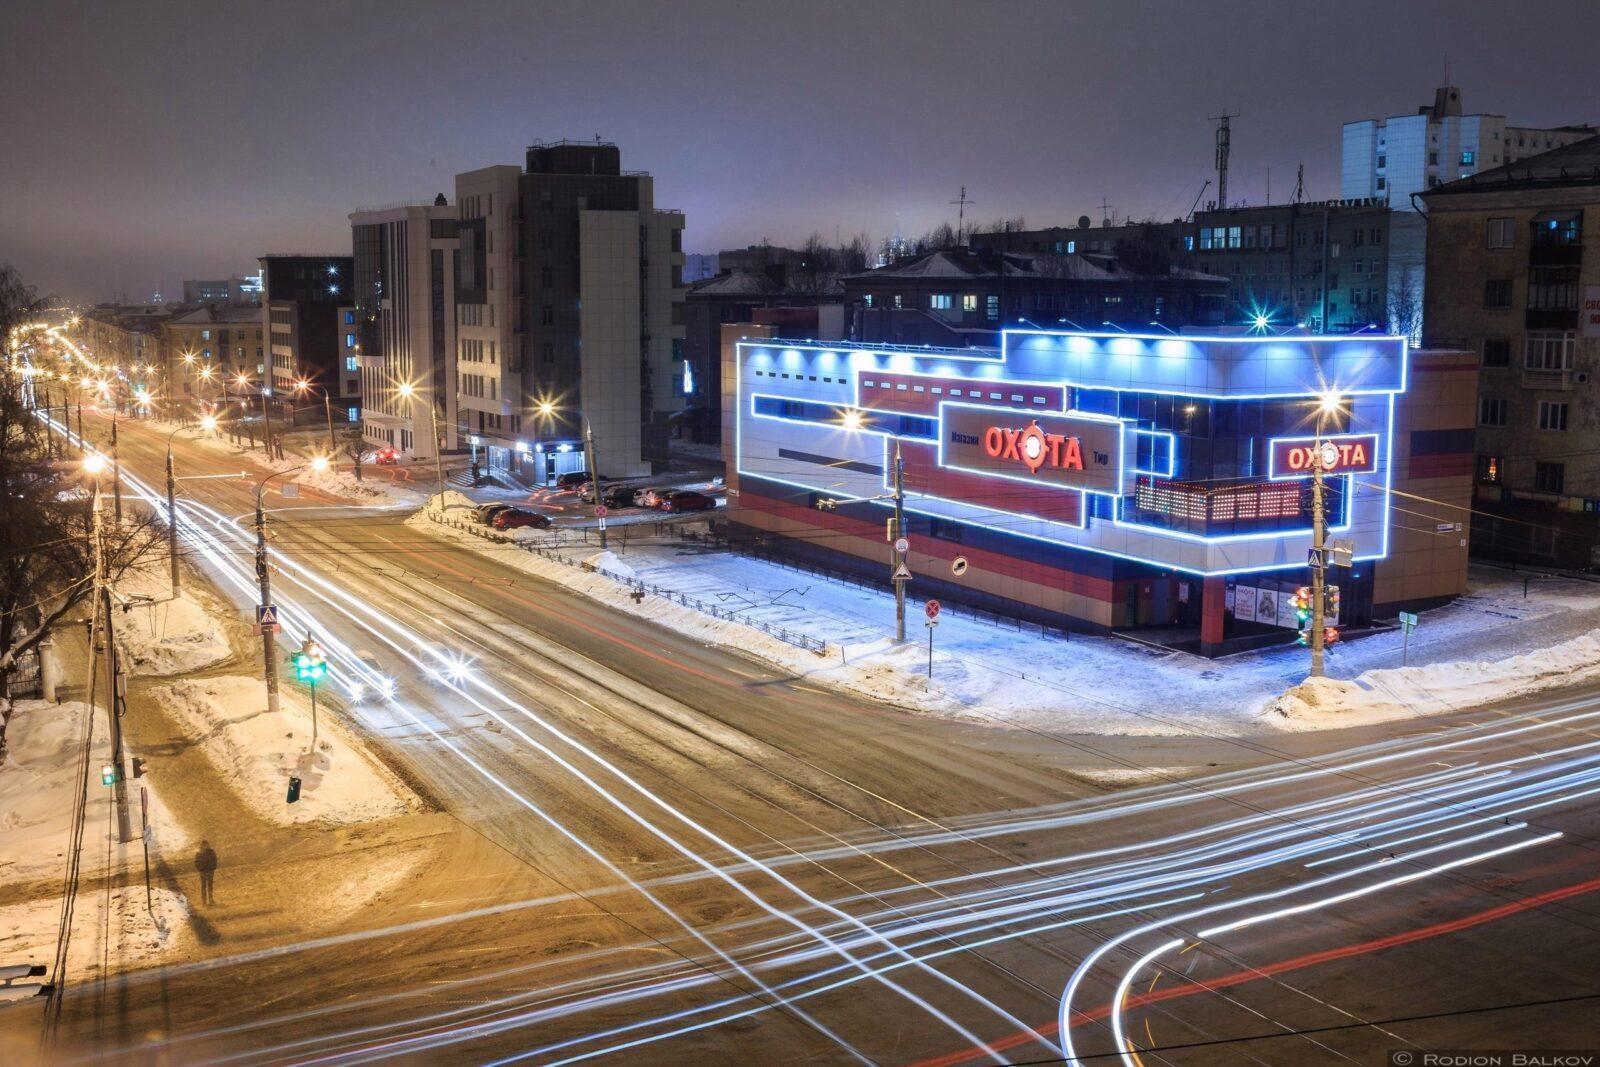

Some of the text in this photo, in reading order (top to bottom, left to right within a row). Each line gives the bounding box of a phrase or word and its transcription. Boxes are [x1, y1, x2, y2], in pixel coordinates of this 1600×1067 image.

[951, 421, 1108, 473] Магазин ОХОТА Тир
[1288, 440, 1366, 470] ОХОТА
